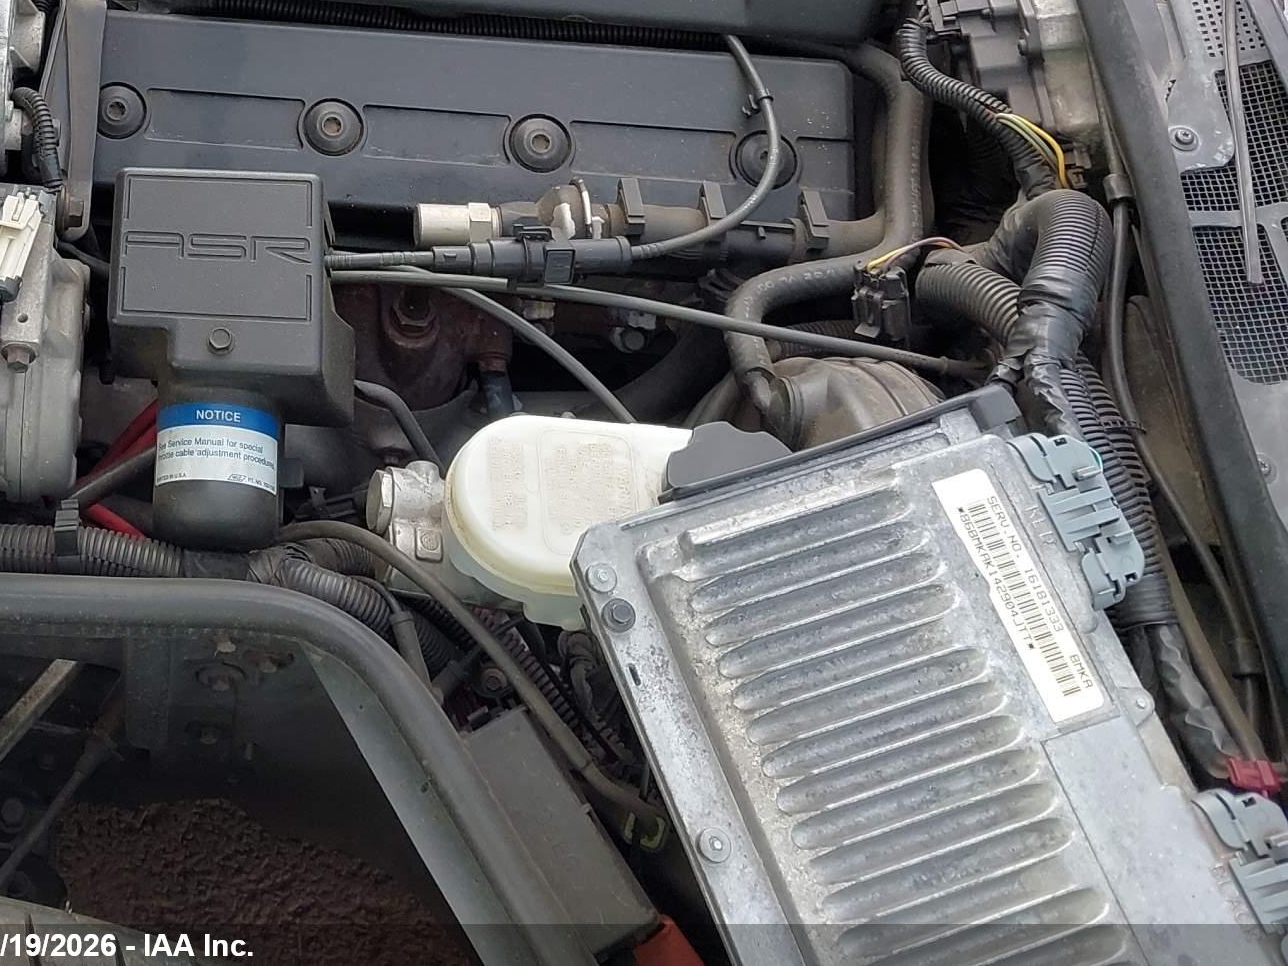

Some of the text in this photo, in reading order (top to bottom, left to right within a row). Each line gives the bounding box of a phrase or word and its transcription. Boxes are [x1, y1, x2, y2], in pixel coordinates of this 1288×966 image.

[122, 229, 313, 265] ASR
[196, 410, 241, 422] NOTICE
[167, 438, 192, 448] Service
[194, 437, 223, 447] Manual
[239, 442, 264, 454] special
[175, 448, 194, 457] cable
[197, 449, 241, 460] adjustment
[1024, 566, 1064, 634] 16181333
[1068, 652, 1094, 690] BMKA
